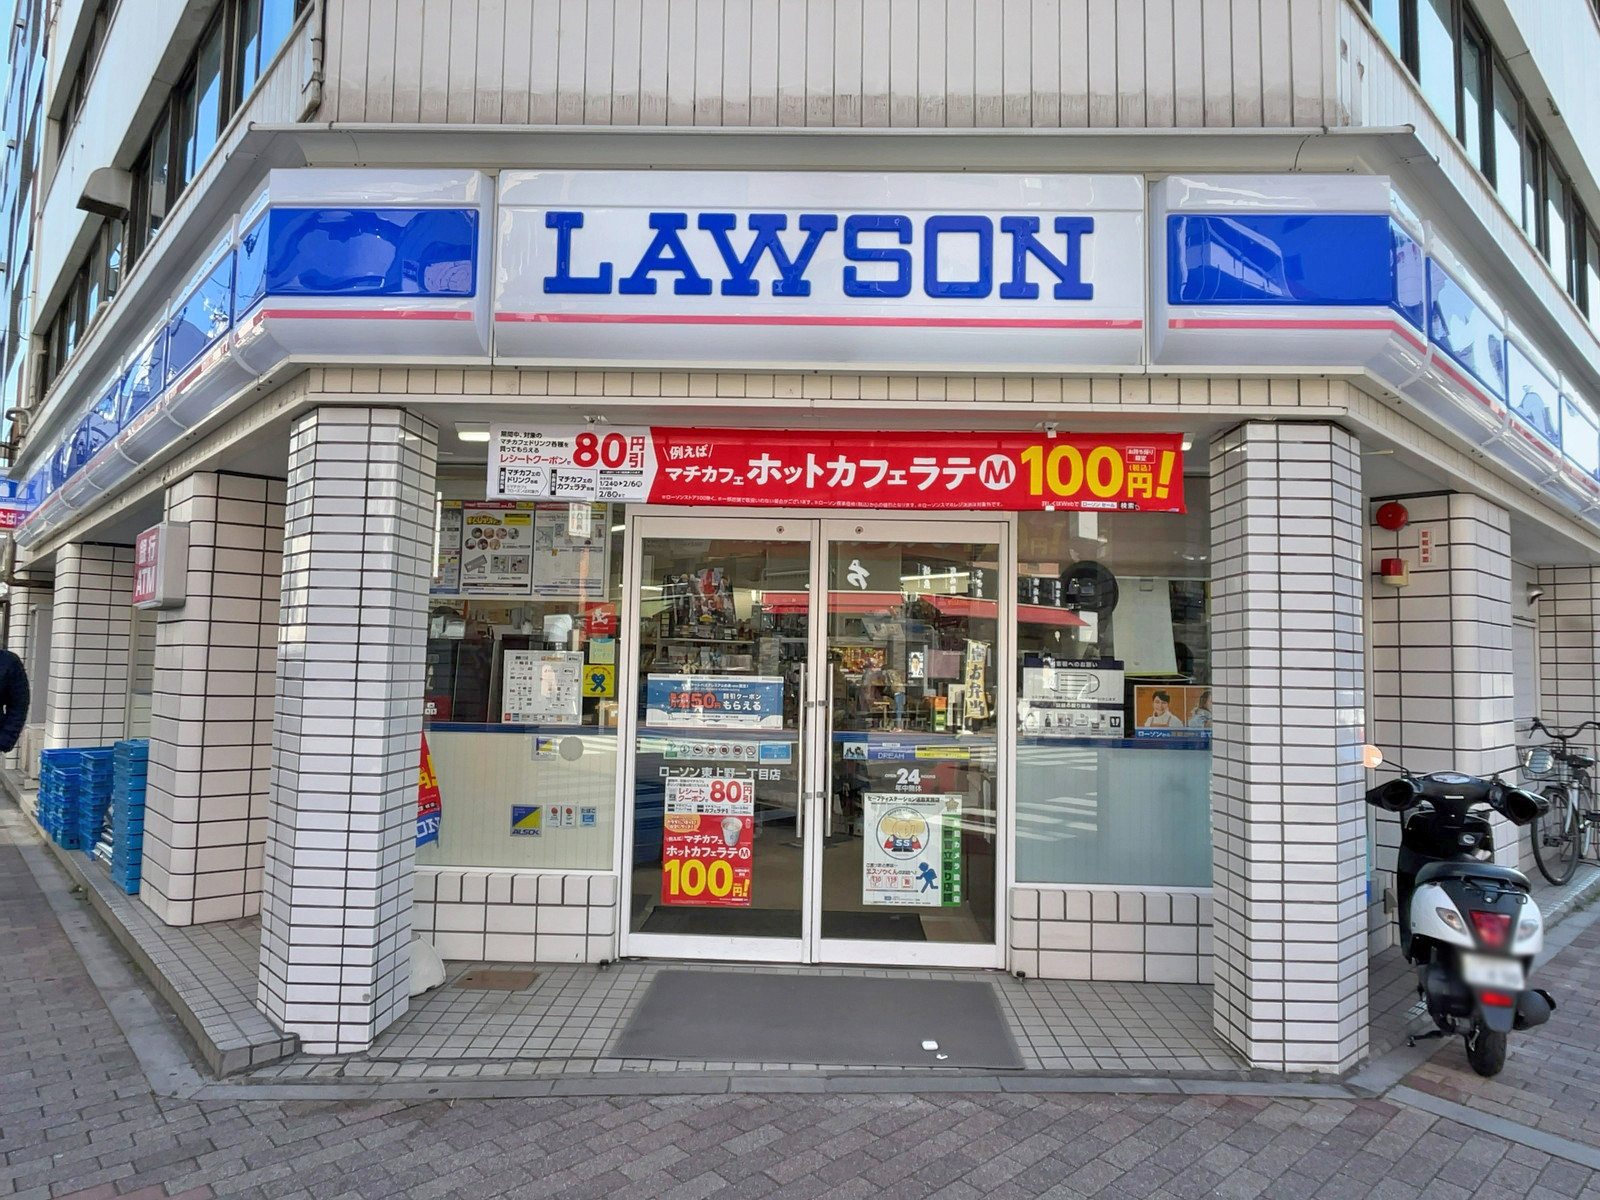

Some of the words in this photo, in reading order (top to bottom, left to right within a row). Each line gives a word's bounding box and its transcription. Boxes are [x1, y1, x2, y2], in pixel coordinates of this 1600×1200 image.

[543, 211, 1094, 300] LAWSON
[572, 432, 628, 468] 80
[664, 465, 745, 486] マチカフェ
[746, 452, 977, 492] ホットカフェラテ
[135, 566, 156, 597] ATM
[722, 700, 762, 711] もらえる
[896, 767, 921, 784] 24
[709, 780, 742, 803] 80
[684, 834, 724, 845] マチカフェ
[666, 845, 739, 859] ホットカフェラテ
